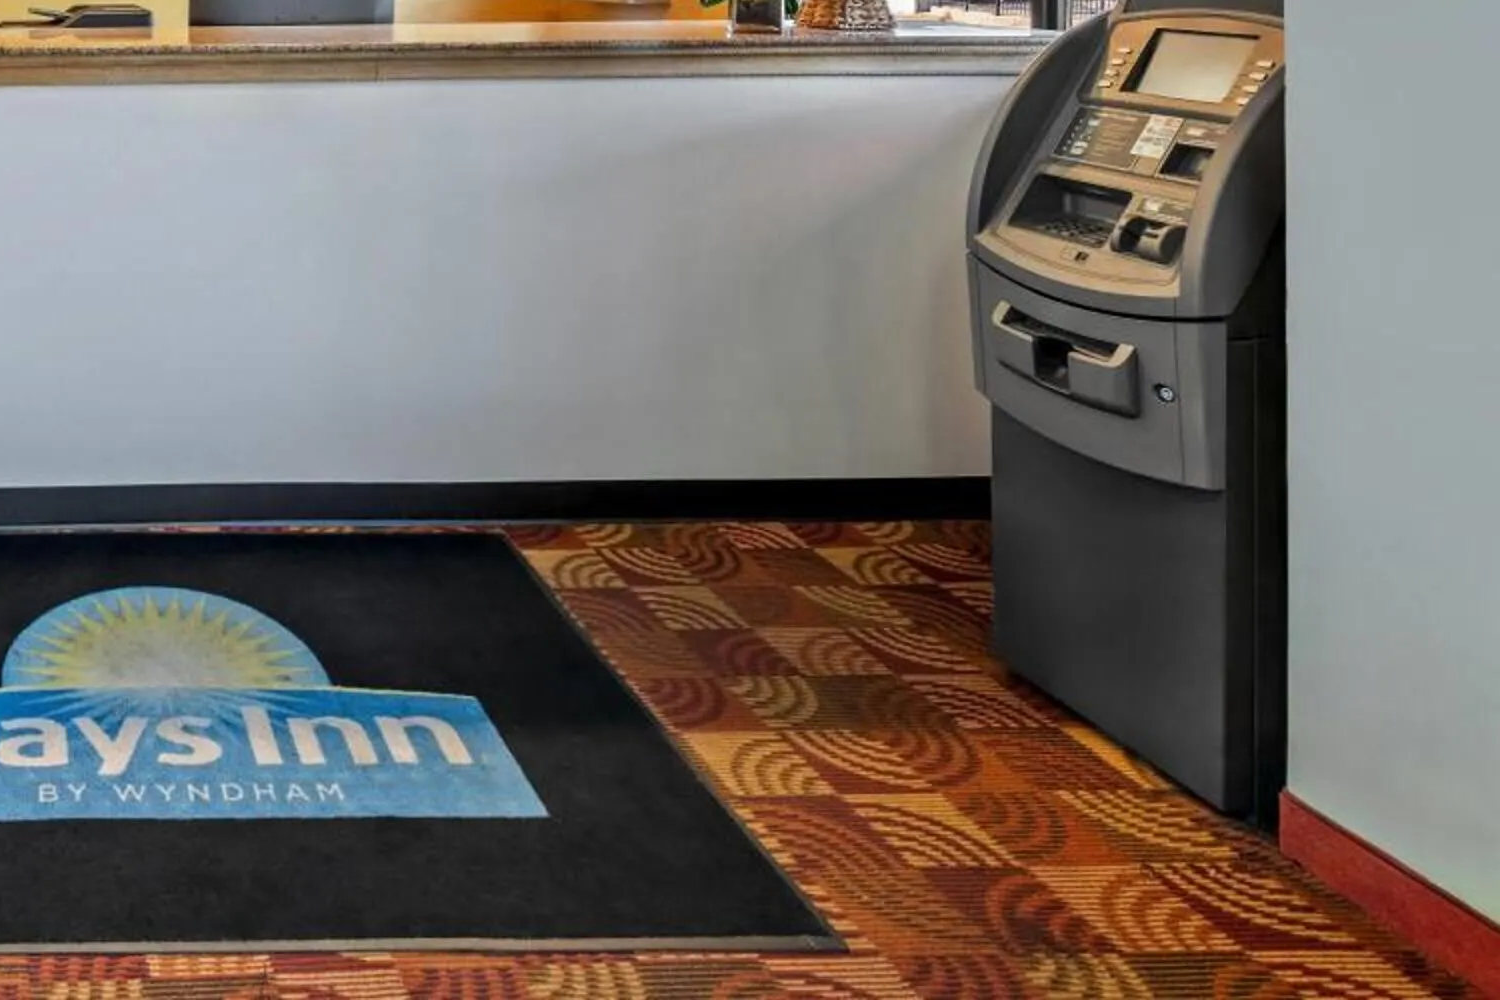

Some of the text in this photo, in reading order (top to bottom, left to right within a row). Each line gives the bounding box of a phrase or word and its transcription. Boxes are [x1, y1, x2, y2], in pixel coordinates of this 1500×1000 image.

[248, 706, 474, 765] Inn
[38, 783, 346, 803] BY WYNDHAM
